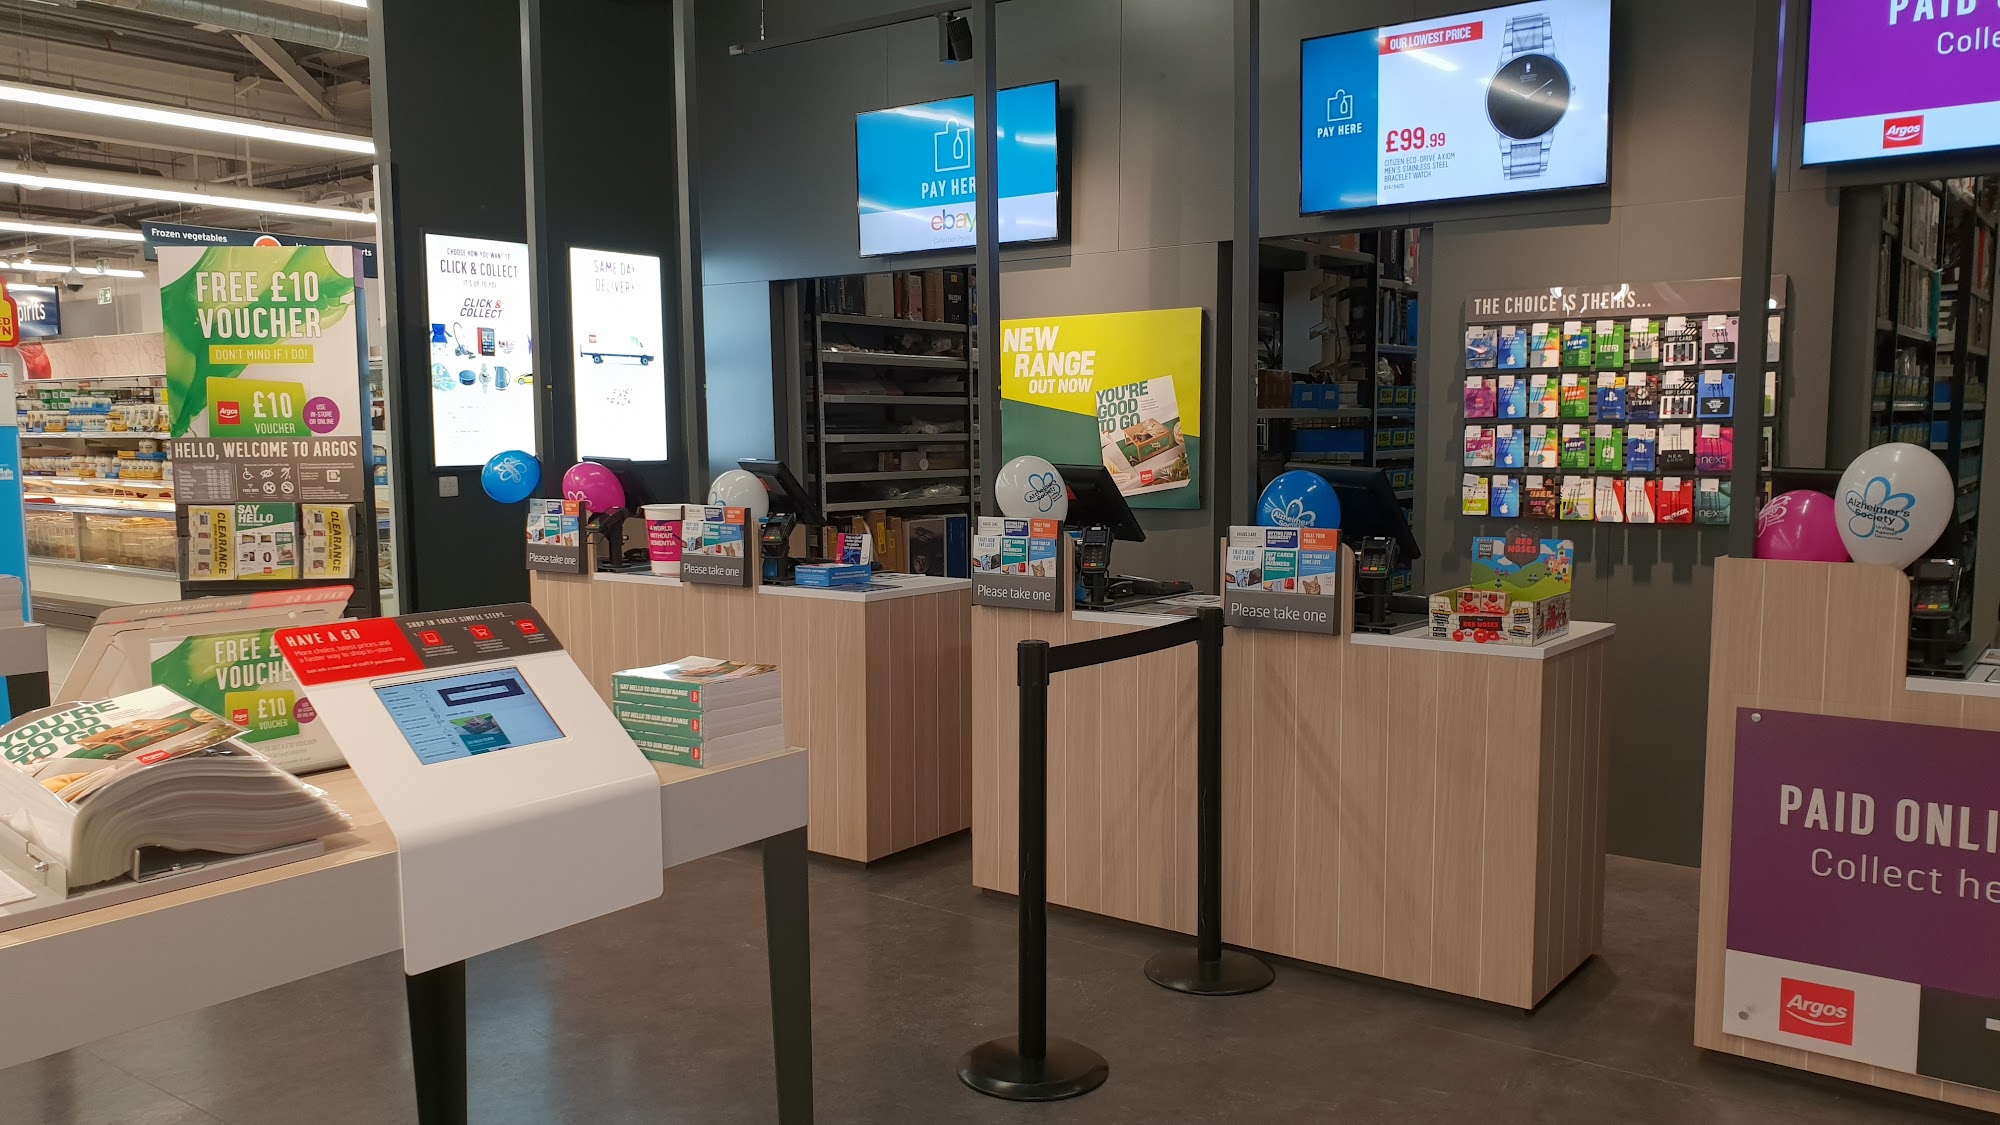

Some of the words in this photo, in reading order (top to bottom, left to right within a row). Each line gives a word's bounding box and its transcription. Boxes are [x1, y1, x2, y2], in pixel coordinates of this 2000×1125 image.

[1889, 0, 1976, 26] PAID
[1390, 36, 1407, 50] OUR
[1408, 31, 1444, 47] LOWEST
[1446, 26, 1472, 41] PRICE
[1937, 26, 2000, 55] Colle
[1317, 126, 1334, 138] PAY
[1338, 122, 1363, 135] HERE
[1385, 126, 1446, 153] £99.99
[1885, 124, 1920, 137] Argos
[1384, 158, 1405, 167] CITIZEN
[1406, 154, 1436, 164] ECO-DRIVE
[1437, 152, 1456, 160] AXIOM
[1384, 166, 1401, 174] MEN'S
[1403, 163, 1431, 173] STAINLESS
[1432, 161, 1449, 169] STEEL
[1384, 172, 1411, 182] BRACELET
[1413, 171, 1432, 179] WATCH
[921, 180, 946, 199] PAY
[951, 176, 976, 195] HER
[931, 208, 976, 233] ebay
[151, 227, 181, 238] Frozen
[182, 231, 228, 244] vegetables
[440, 259, 467, 274] CLICK
[470, 262, 477, 275] &
[480, 262, 518, 278] COLLECT
[594, 259, 616, 274] SAME
[620, 262, 636, 276] DAY
[196, 271, 260, 303] FREE
[270, 271, 320, 303] £10
[460, 307, 503, 318] COLLECT
[464, 297, 493, 308] CLICK
[494, 299, 502, 309] &
[1474, 297, 1500, 315] THE
[1504, 294, 1557, 314] CHOICE
[1562, 293, 1576, 311] IS
[1582, 290, 1652, 312] THEIRS...
[197, 307, 323, 339] VOUCHER
[1003, 325, 1060, 353] NEW
[215, 349, 244, 361] DON'T
[246, 348, 272, 360] MIND
[273, 348, 283, 360] IF
[290, 347, 308, 360] DO!
[1014, 350, 1096, 378] RANGE
[1028, 378, 1056, 394] OUT
[1057, 378, 1093, 394] NOW
[1096, 380, 1149, 405] YOU'RE
[219, 407, 238, 415] Argos
[253, 391, 293, 419] £10
[1097, 398, 1138, 420] GOOD
[254, 423, 296, 434] VOUCHER
[1098, 417, 1117, 434] TO
[1119, 412, 1141, 431] GO
[174, 442, 219, 461] HELLO,
[223, 441, 290, 458] WELCOME
[292, 441, 309, 457] TO
[313, 441, 357, 457] ARGOS
[1701, 455, 1728, 464] next
[237, 504, 260, 514] SAY
[1847, 497, 1910, 517] Alzheimer's
[1855, 508, 1895, 525] Society
[238, 513, 274, 523] HELLO
[1273, 510, 1315, 527] Alzheimer's
[217, 512, 228, 575] CLEARANCE
[331, 511, 342, 572] CLEARANCE
[1507, 545, 1537, 553] NOSES
[1515, 537, 1533, 545] RED
[529, 552, 549, 564] Please
[550, 554, 563, 565] take
[564, 557, 576, 566] one
[683, 562, 708, 575] Please
[708, 565, 725, 576] take
[725, 568, 740, 577] one
[977, 584, 1008, 598] Please
[1010, 586, 1031, 600] take
[1032, 590, 1051, 601] one
[406, 620, 424, 628] SHOP
[436, 617, 459, 625] THREE
[459, 614, 483, 623] SIMPLE
[483, 611, 513, 621] STEPS...
[1230, 602, 1271, 618] Please
[1273, 605, 1300, 621] take
[1303, 610, 1327, 623] one
[285, 632, 324, 647] HAVE
[327, 631, 338, 642] A
[340, 628, 360, 640] GO
[215, 637, 261, 664] FREE
[216, 661, 292, 690] VOUCHE
[258, 697, 287, 719] £10
[0, 700, 120, 749] YOU'RE
[259, 719, 288, 730] VOUCHER
[4, 716, 102, 760] GOOD
[1779, 783, 1875, 836] PAID
[1895, 798, 2000, 854] ONLI
[1810, 848, 1943, 895] Collect
[1959, 868, 2000, 904] he
[1785, 993, 1848, 1019] Argos
